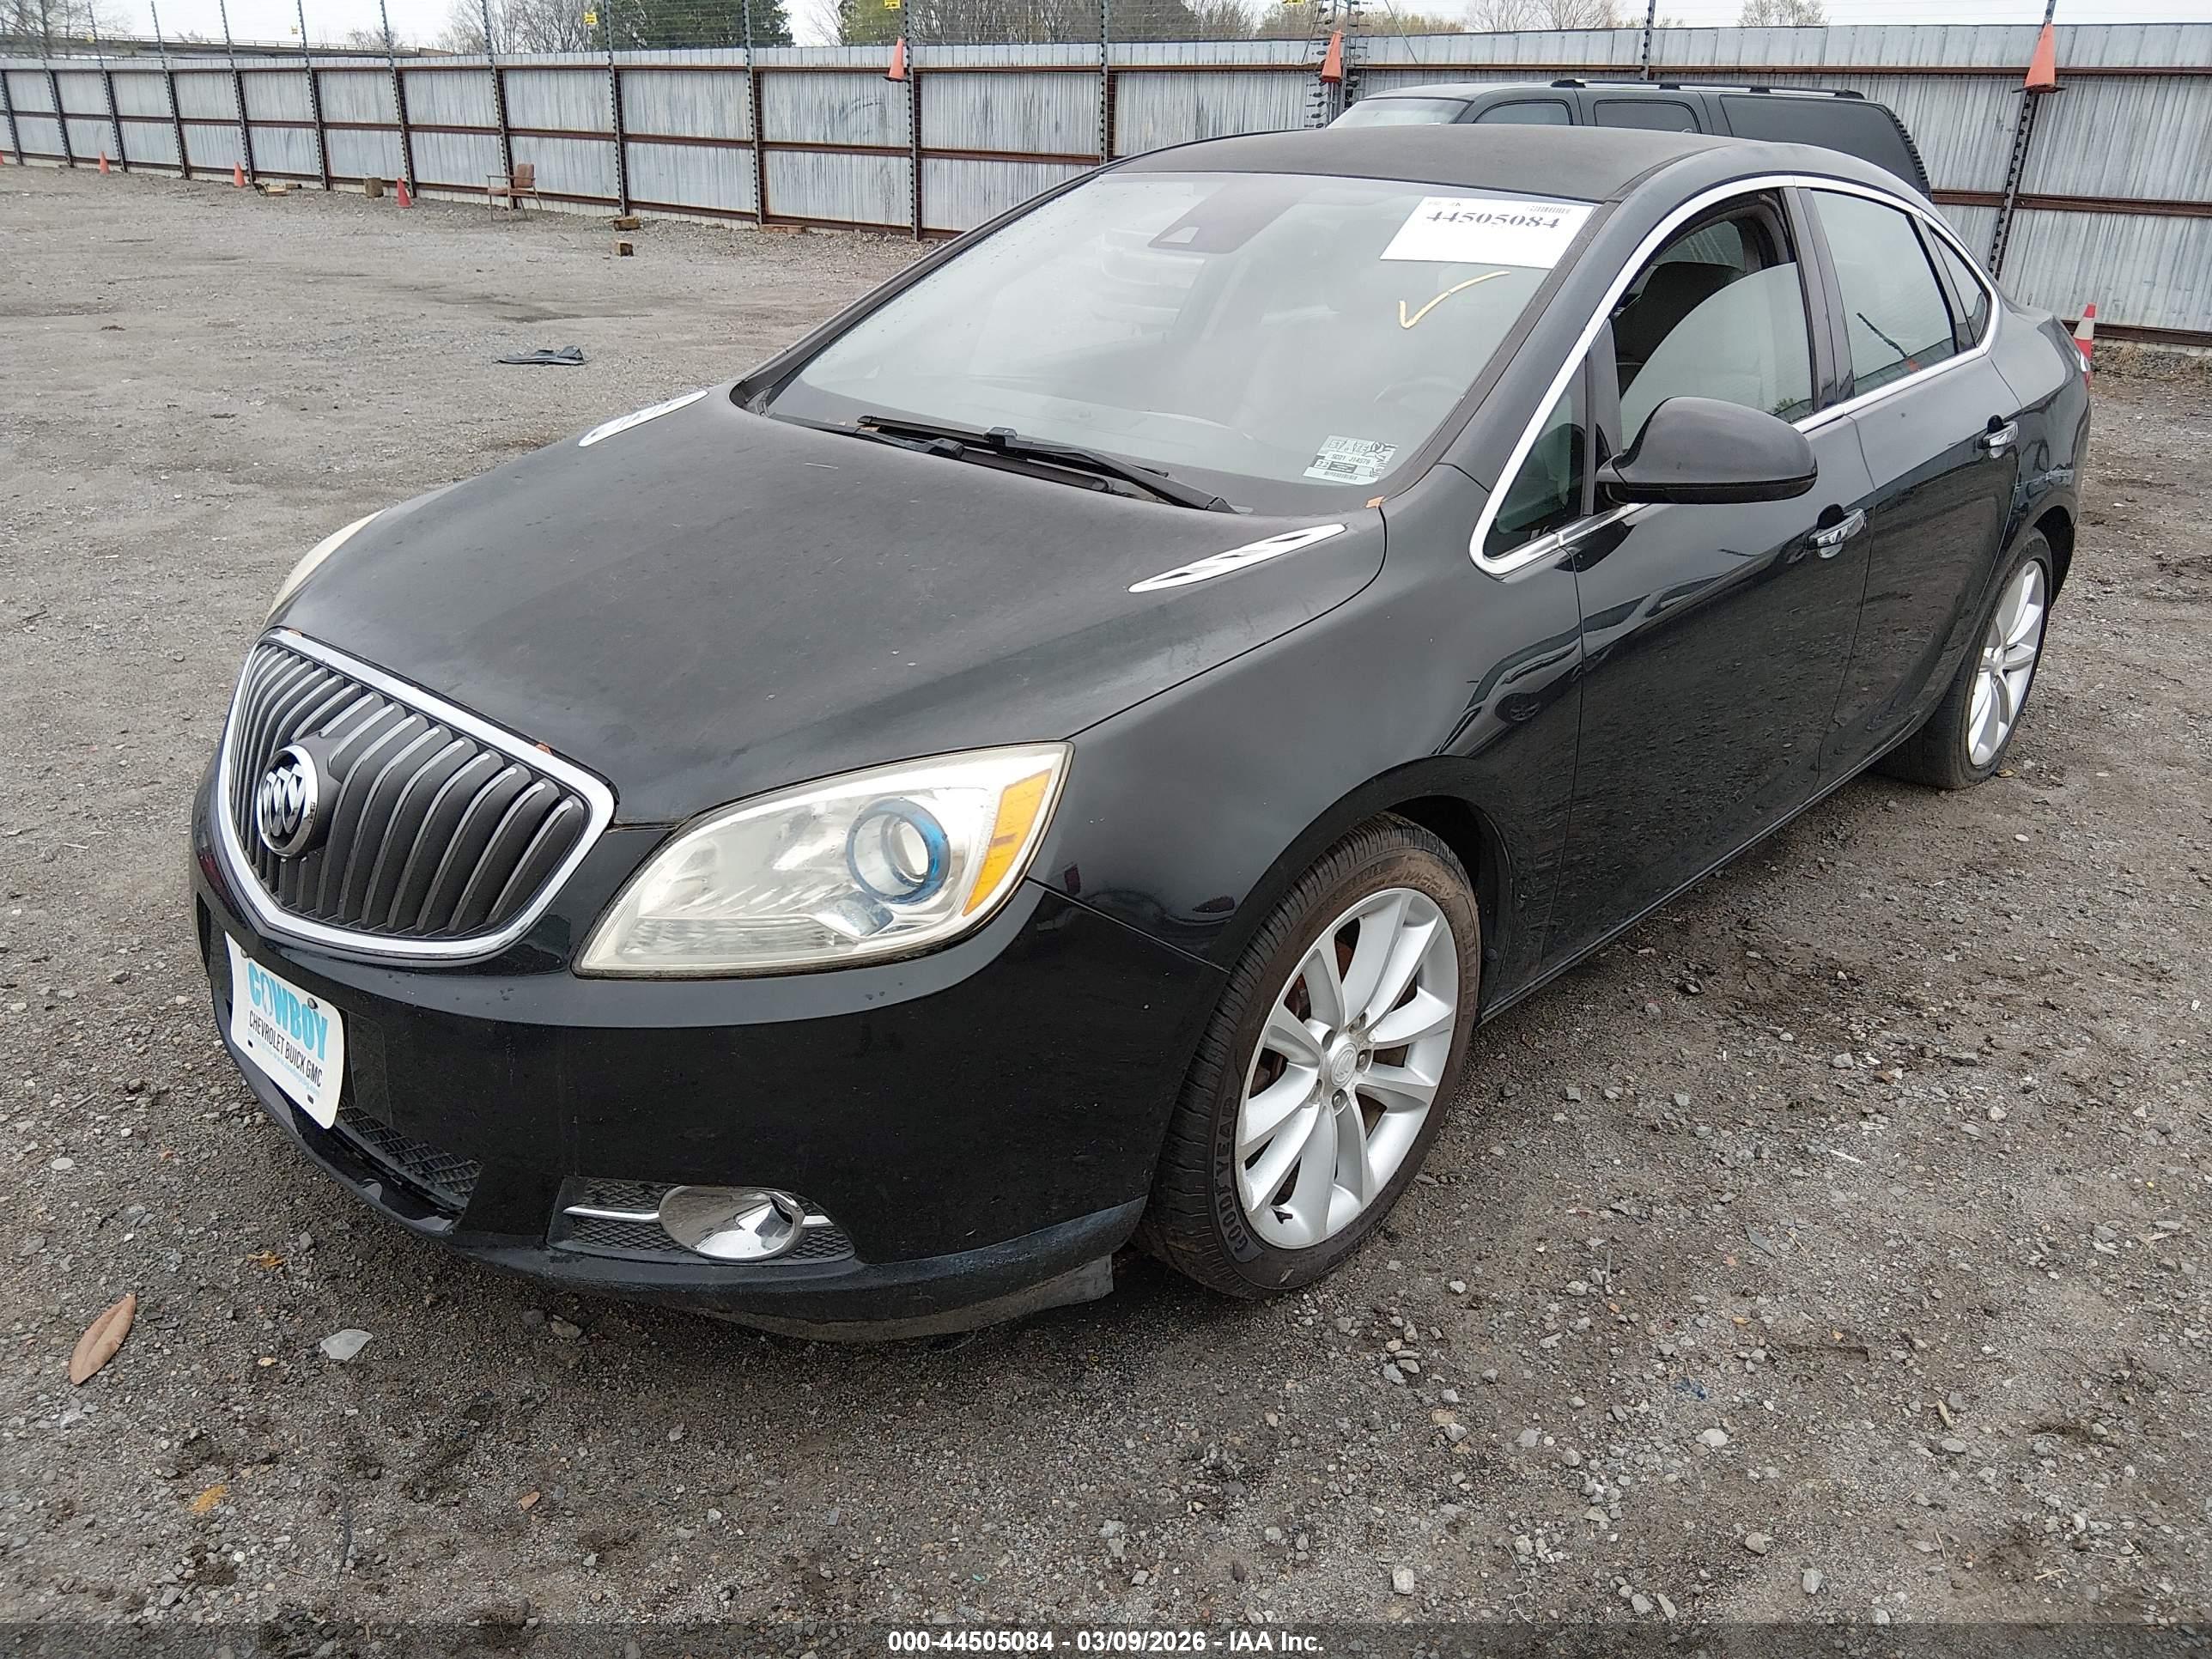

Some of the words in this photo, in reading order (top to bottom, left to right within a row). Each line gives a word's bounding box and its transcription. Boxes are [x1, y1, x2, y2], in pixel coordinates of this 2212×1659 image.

[1426, 210, 1560, 228] 44505084
[248, 962, 328, 1061] COWBOY
[249, 1010, 285, 1055] CHEVROLET
[285, 1041, 307, 1073] BUICK
[306, 1058, 323, 1088] GMC
[1215, 1096, 1249, 1253] GOODYEAR
